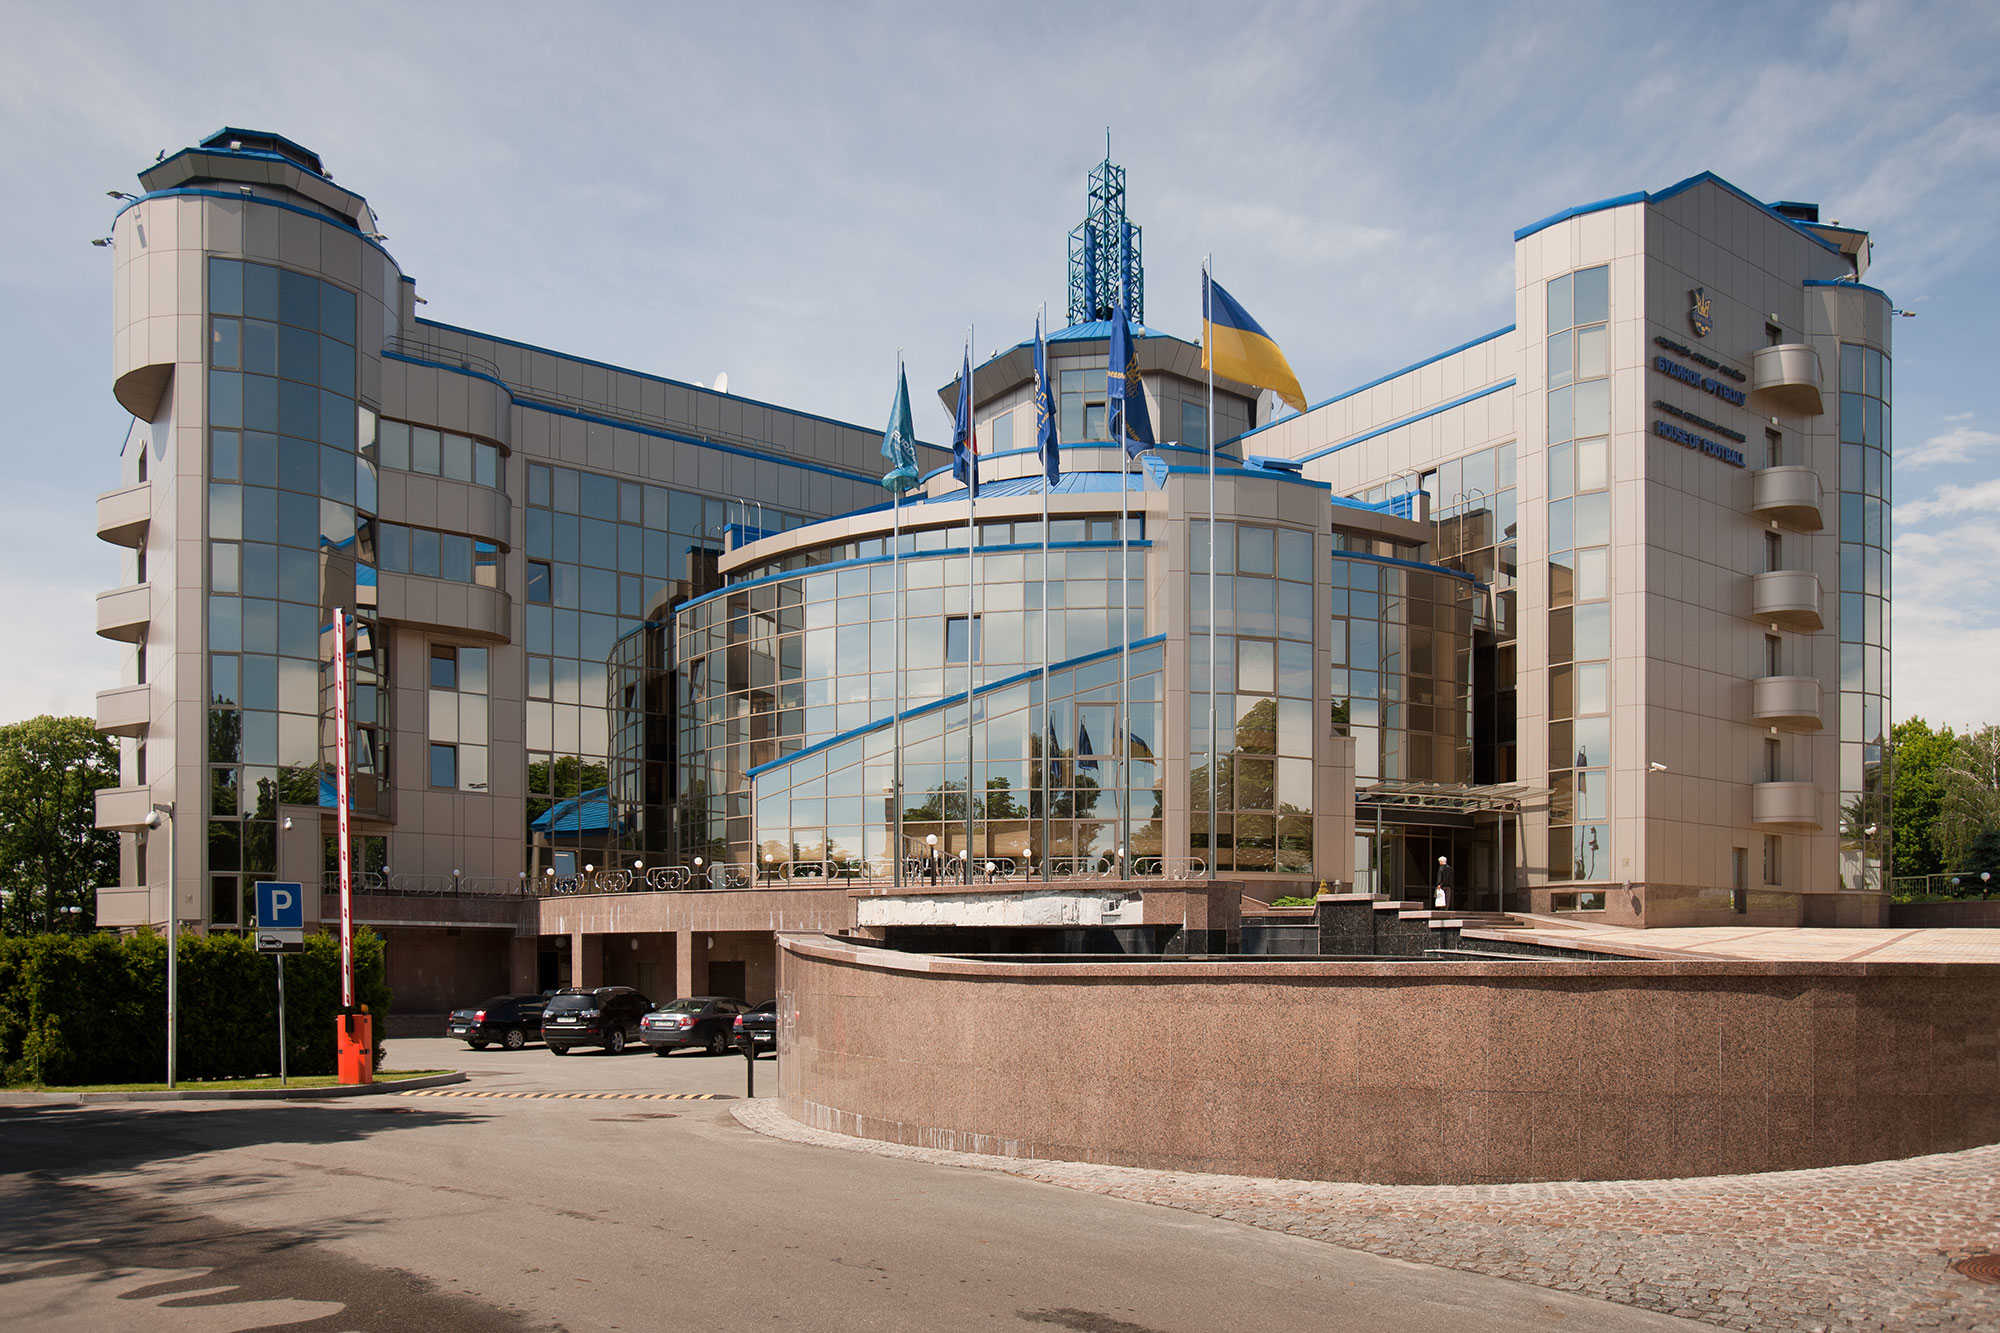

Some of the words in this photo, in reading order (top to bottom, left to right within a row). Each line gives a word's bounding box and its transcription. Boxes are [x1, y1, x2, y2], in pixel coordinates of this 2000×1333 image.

[1656, 356, 1701, 387] БУДИНОК
[1704, 377, 1746, 405] ФУТБОЛУ
[1657, 420, 1688, 444] HOUSE
[1688, 432, 1701, 448] OF
[1703, 438, 1746, 467] FOOTBALL
[272, 890, 292, 920] P
